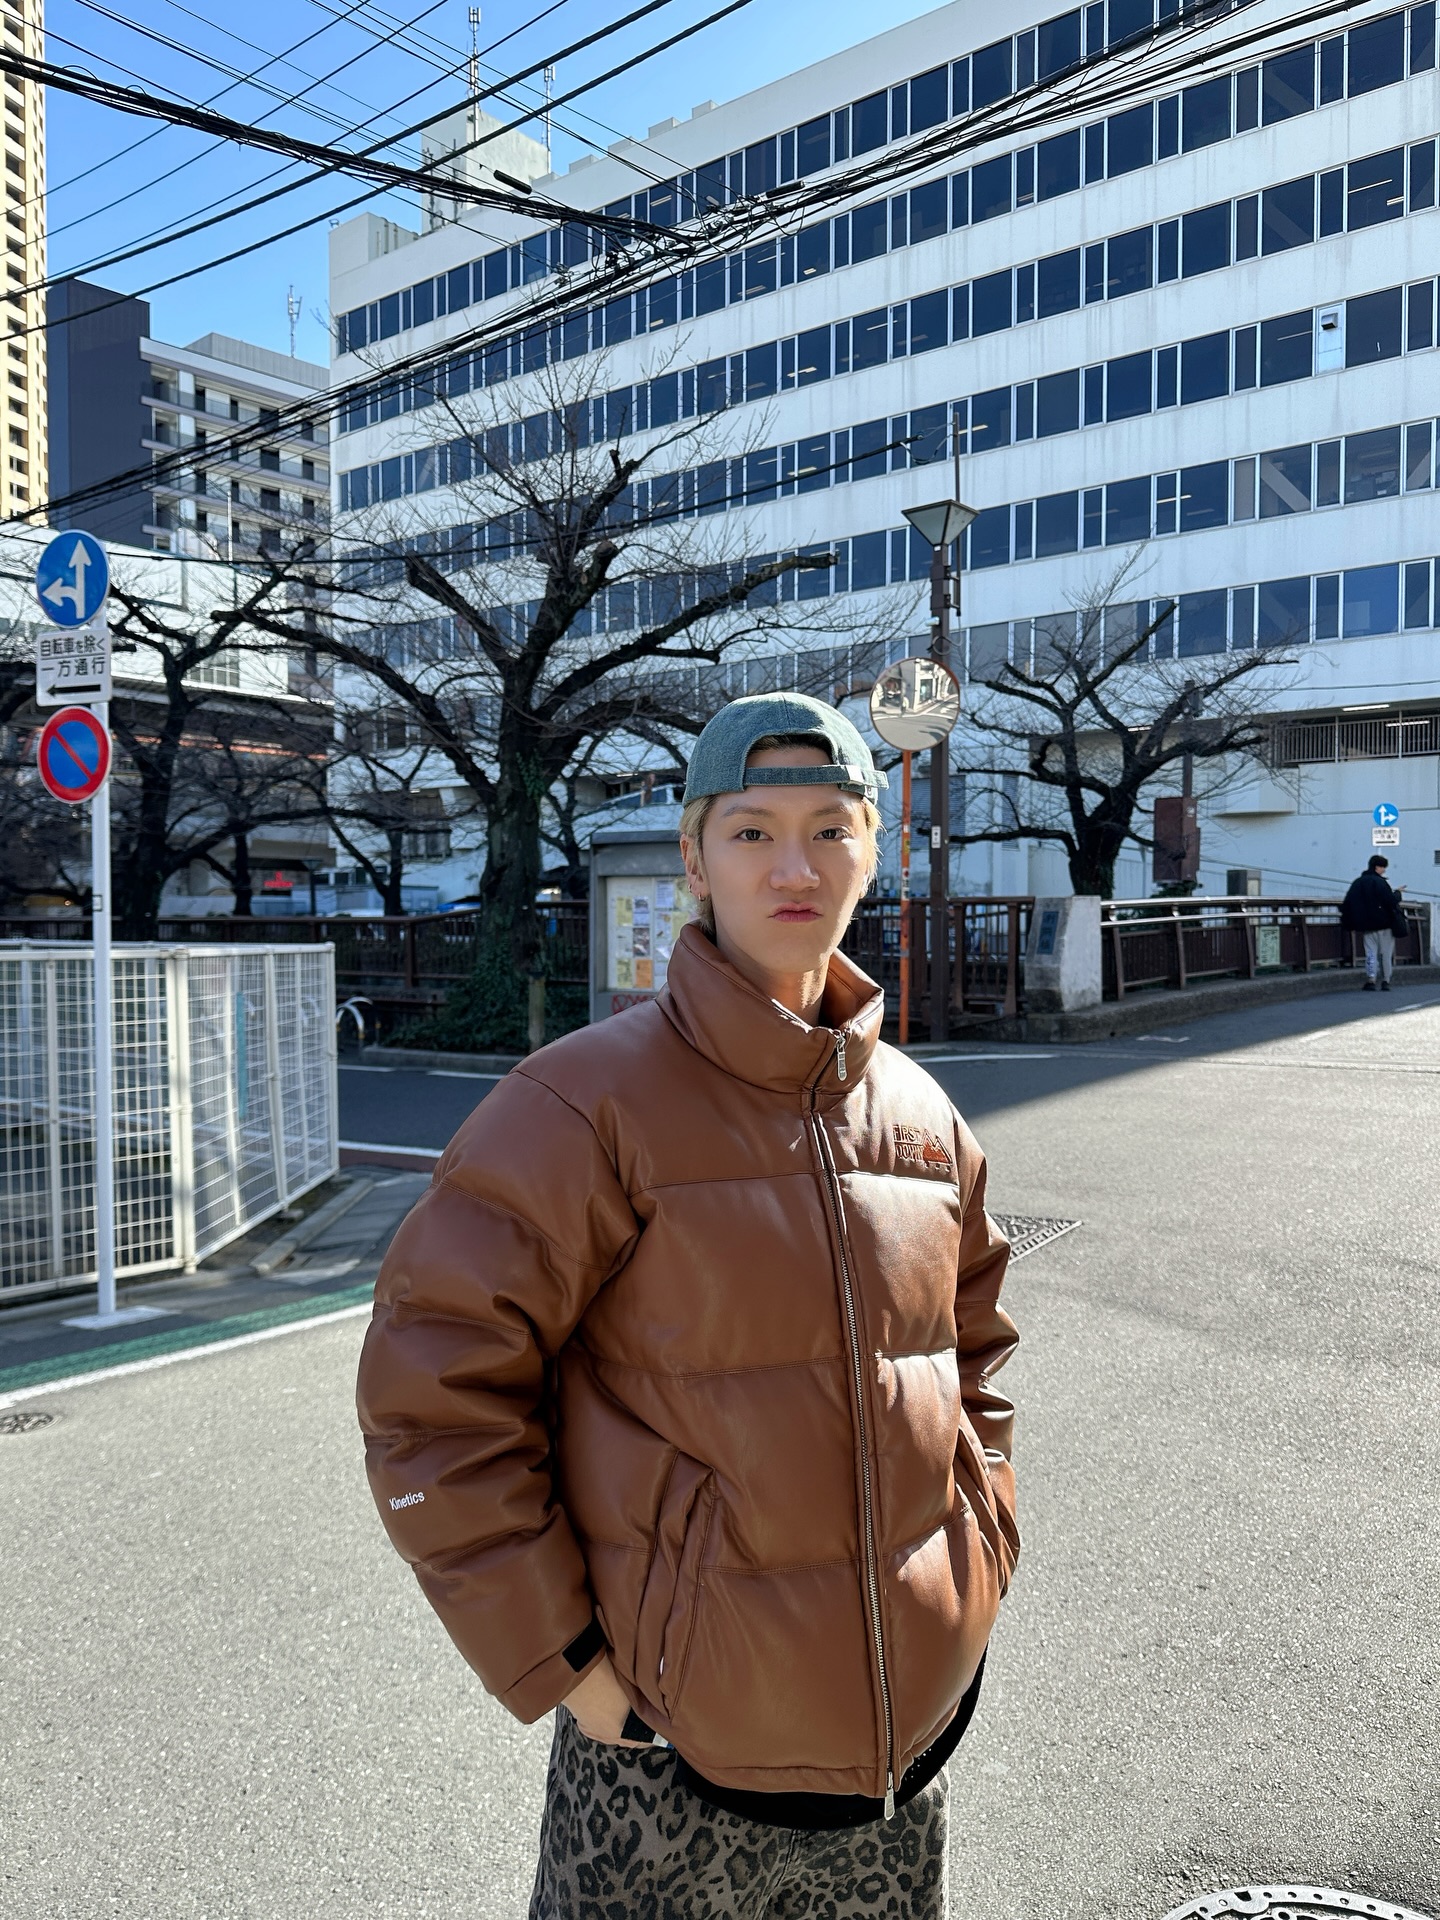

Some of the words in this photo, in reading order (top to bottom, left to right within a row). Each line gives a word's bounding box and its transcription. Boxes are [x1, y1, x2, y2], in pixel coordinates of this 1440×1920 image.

[40, 635, 105, 656] 自転車を除く
[41, 656, 106, 678] 一方通行
[389, 1491, 425, 1511] Kinetics
